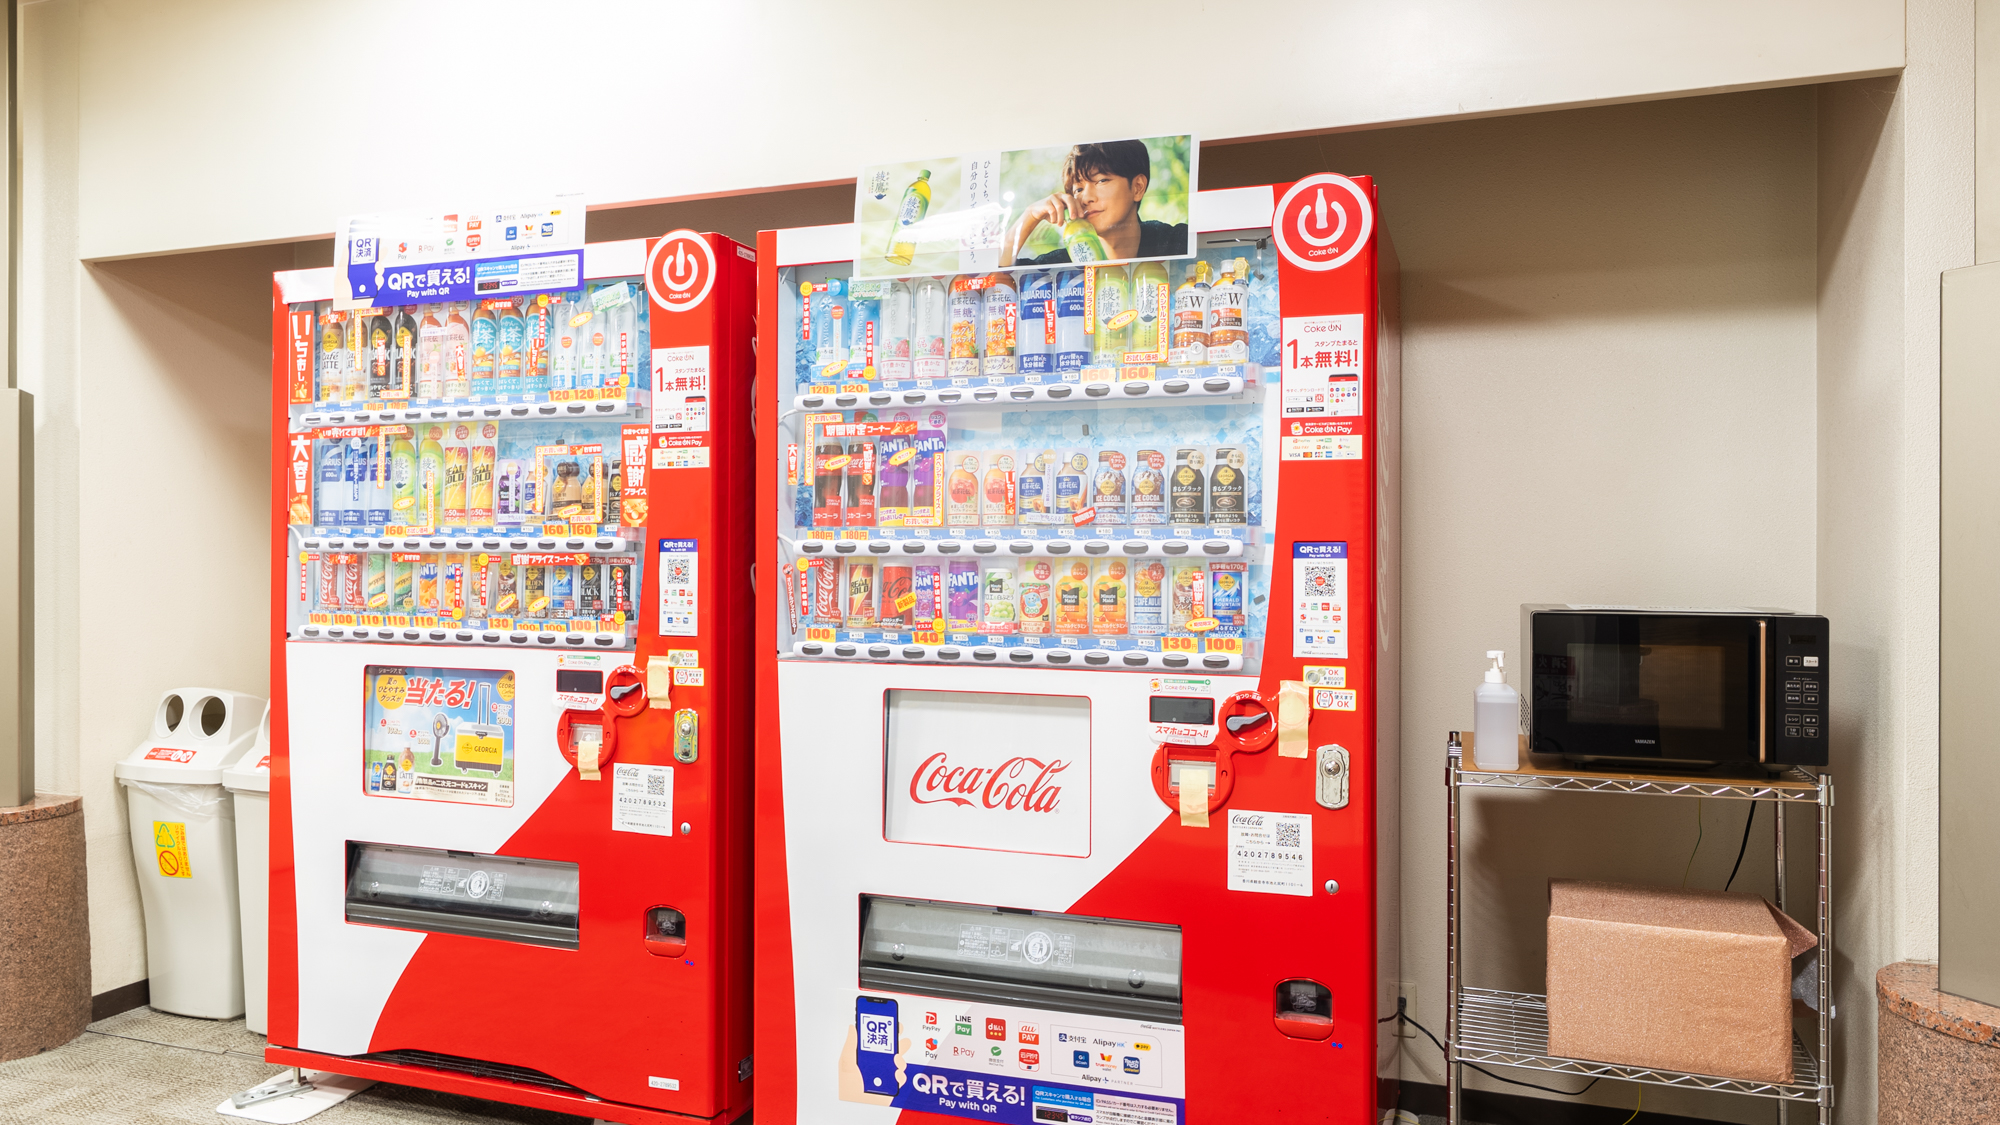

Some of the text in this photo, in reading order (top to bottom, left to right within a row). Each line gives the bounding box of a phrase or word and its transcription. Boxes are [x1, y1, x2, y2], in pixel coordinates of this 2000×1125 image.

[356, 238, 372, 248] QR
[356, 248, 372, 258] 決済
[1308, 248, 1326, 257] Coke
[388, 266, 471, 291] QRで買える!
[407, 287, 450, 298] Pay with QR
[1020, 290, 1052, 300] AQUARIUS
[1058, 288, 1085, 298] AQUARIU
[1102, 286, 1116, 316] 綾鷹
[1190, 296, 1204, 309] W
[1229, 292, 1244, 306] W
[953, 308, 972, 318] 無糖
[1304, 324, 1342, 333] Coke ON
[292, 314, 312, 382] いちおし
[1315, 340, 1358, 348] スタンプたまると
[684, 353, 694, 361] ON
[1126, 354, 1159, 362] お試し価格
[1286, 338, 1359, 370] 1本無料!
[1121, 366, 1154, 380] 160円
[656, 367, 706, 392] 1本無料!
[1325, 425, 1336, 434] ON
[1338, 426, 1352, 435] Pay
[881, 440, 909, 454] FANTA
[915, 438, 944, 452] FANTA
[291, 436, 310, 493] 大容量
[624, 435, 648, 488] 感謝
[811, 531, 833, 540] 180円
[845, 531, 868, 540] 180円
[1024, 606, 1039, 614] Qoo
[1164, 638, 1198, 650] 130円
[1206, 638, 1242, 651] 100円
[404, 677, 476, 708] 当たる!
[1156, 726, 1209, 738] スマホはココへ!!
[474, 746, 498, 754] GEORGIA
[616, 766, 640, 778] Coca-Cola
[910, 752, 1072, 813] Coca-Cola
[1232, 814, 1264, 826] Coca-Cola
[1237, 850, 1302, 861] 4202789546
[866, 1020, 888, 1036] QR
[957, 1025, 970, 1034] Pay
[1021, 1024, 1036, 1032] au
[867, 1032, 888, 1046] 決済
[1022, 1033, 1036, 1042] PAY
[1068, 1035, 1086, 1044] 支付宝
[1092, 1038, 1116, 1048] Alipay
[926, 1051, 938, 1060] Pay
[961, 1048, 975, 1058] Pay
[1082, 1074, 1102, 1083] Alipay
[912, 1073, 1026, 1107] QRで買える!
[940, 1098, 998, 1114] Pay with QR
[1044, 1112, 1064, 1120] 12345
